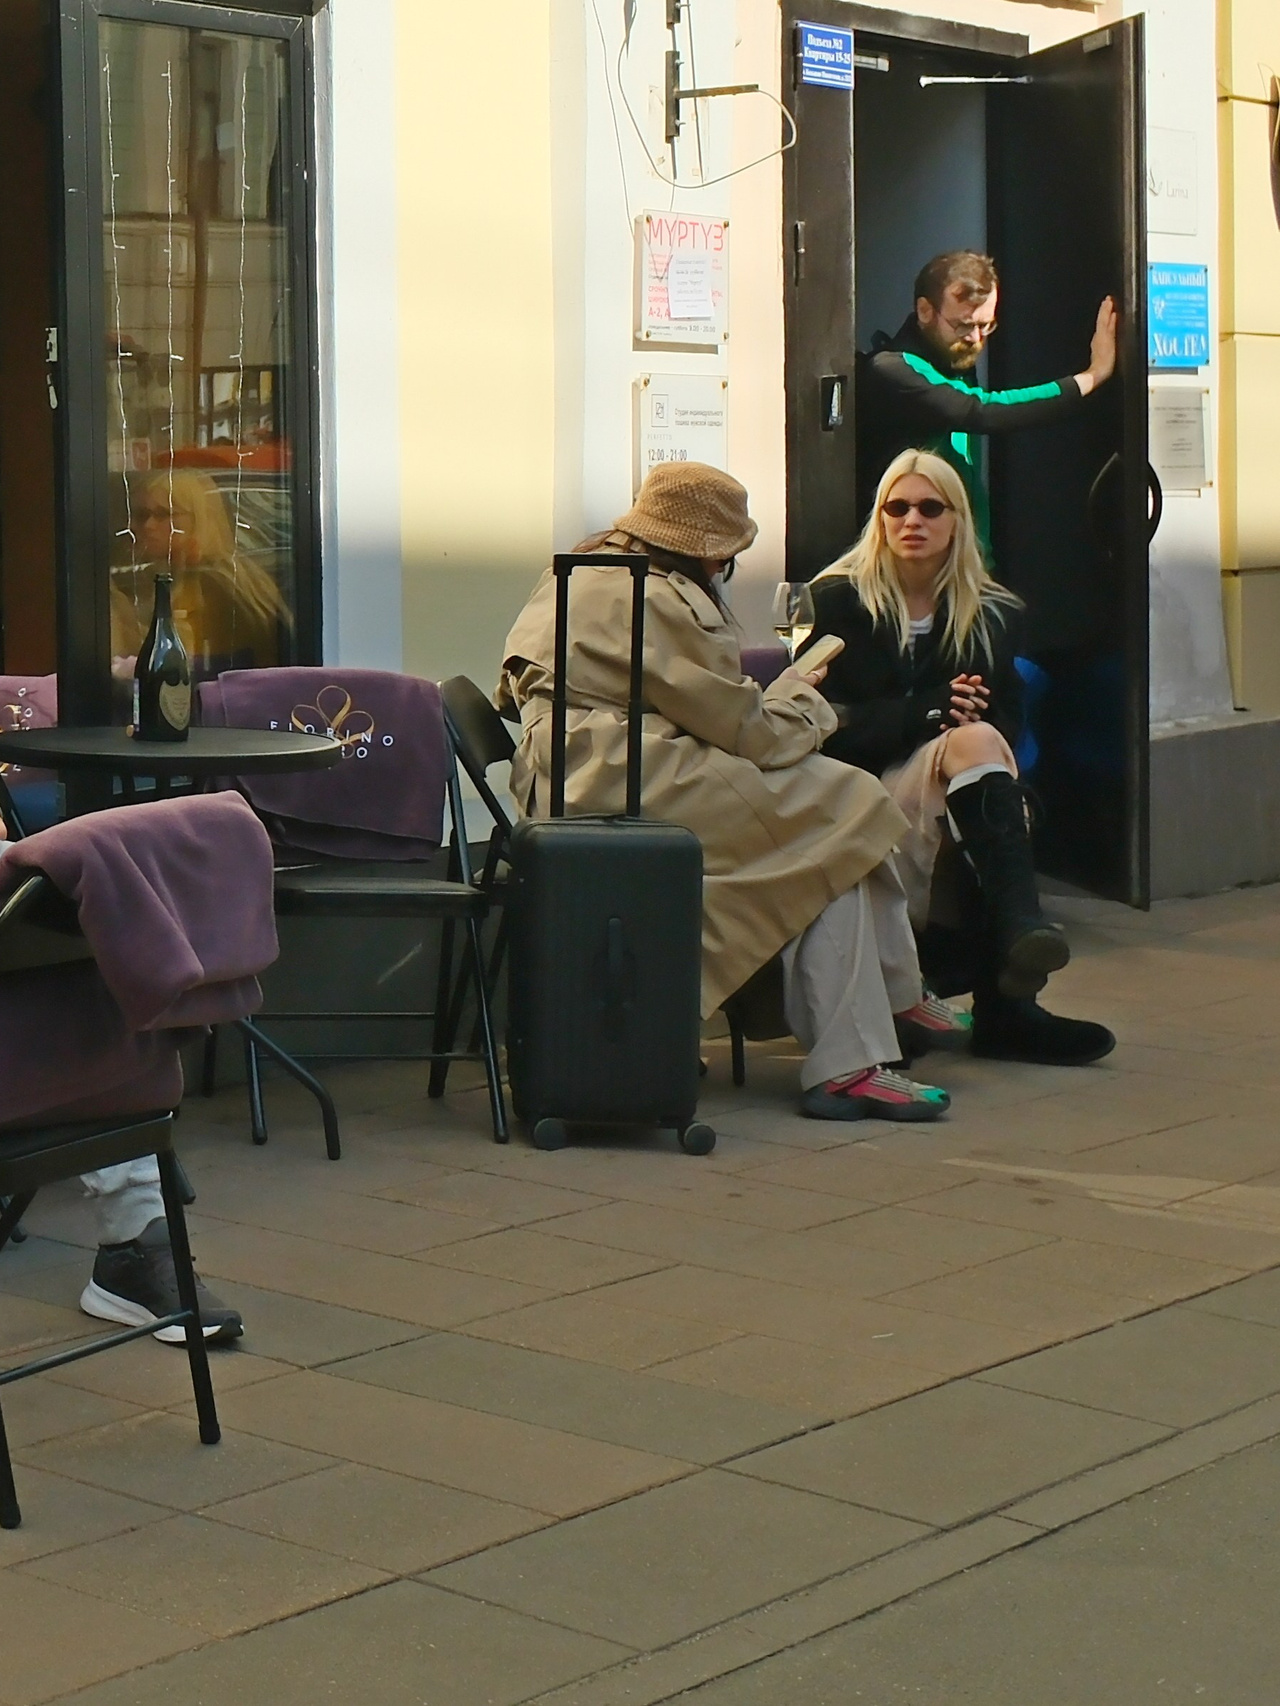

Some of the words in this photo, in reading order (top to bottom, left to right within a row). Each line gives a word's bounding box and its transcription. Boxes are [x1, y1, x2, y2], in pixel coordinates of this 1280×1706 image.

[648, 218, 724, 252] МУРТУЗ
[1154, 333, 1206, 357] ХОСТЕЛ
[270, 720, 394, 747] FIORINO
